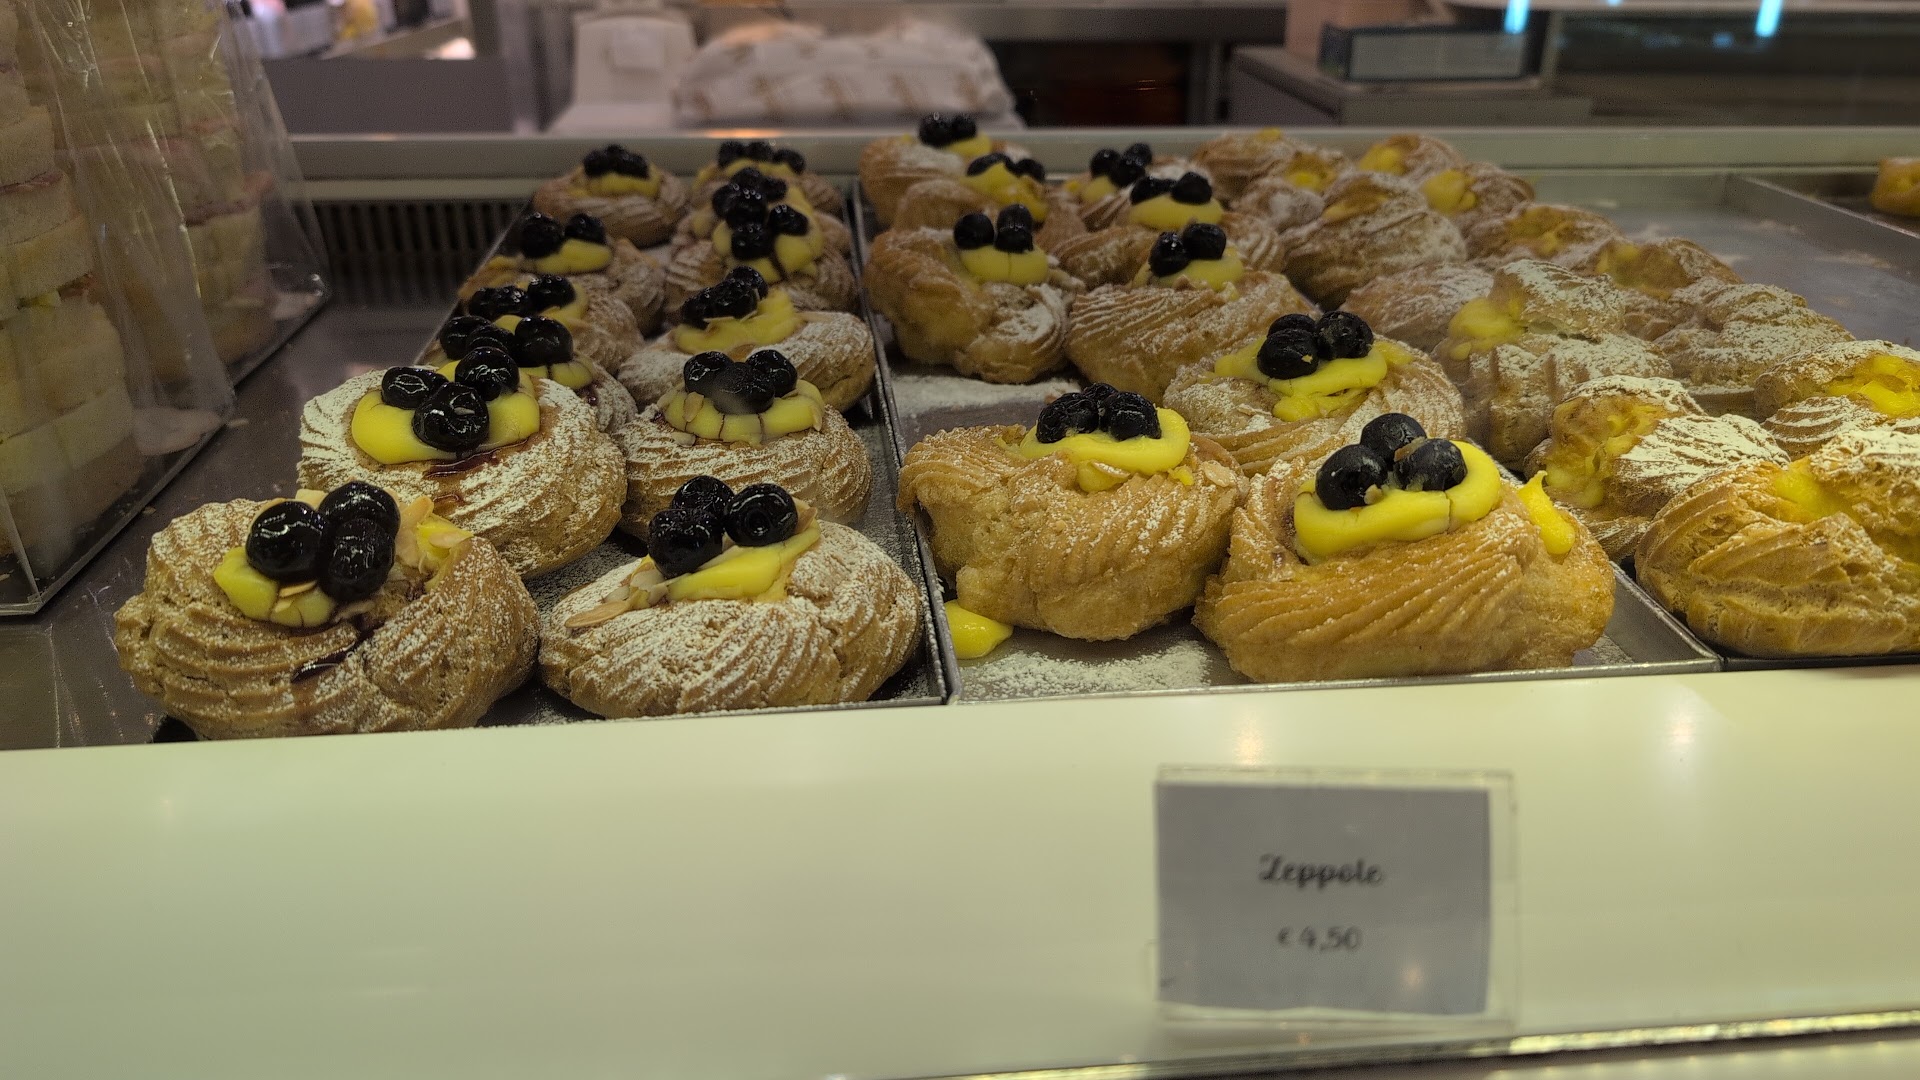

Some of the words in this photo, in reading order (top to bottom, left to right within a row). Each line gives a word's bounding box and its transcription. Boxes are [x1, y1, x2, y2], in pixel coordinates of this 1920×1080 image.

[1259, 853, 1383, 890] Zeppole
[1277, 926, 1292, 947] €
[1299, 926, 1362, 952] 4,50
